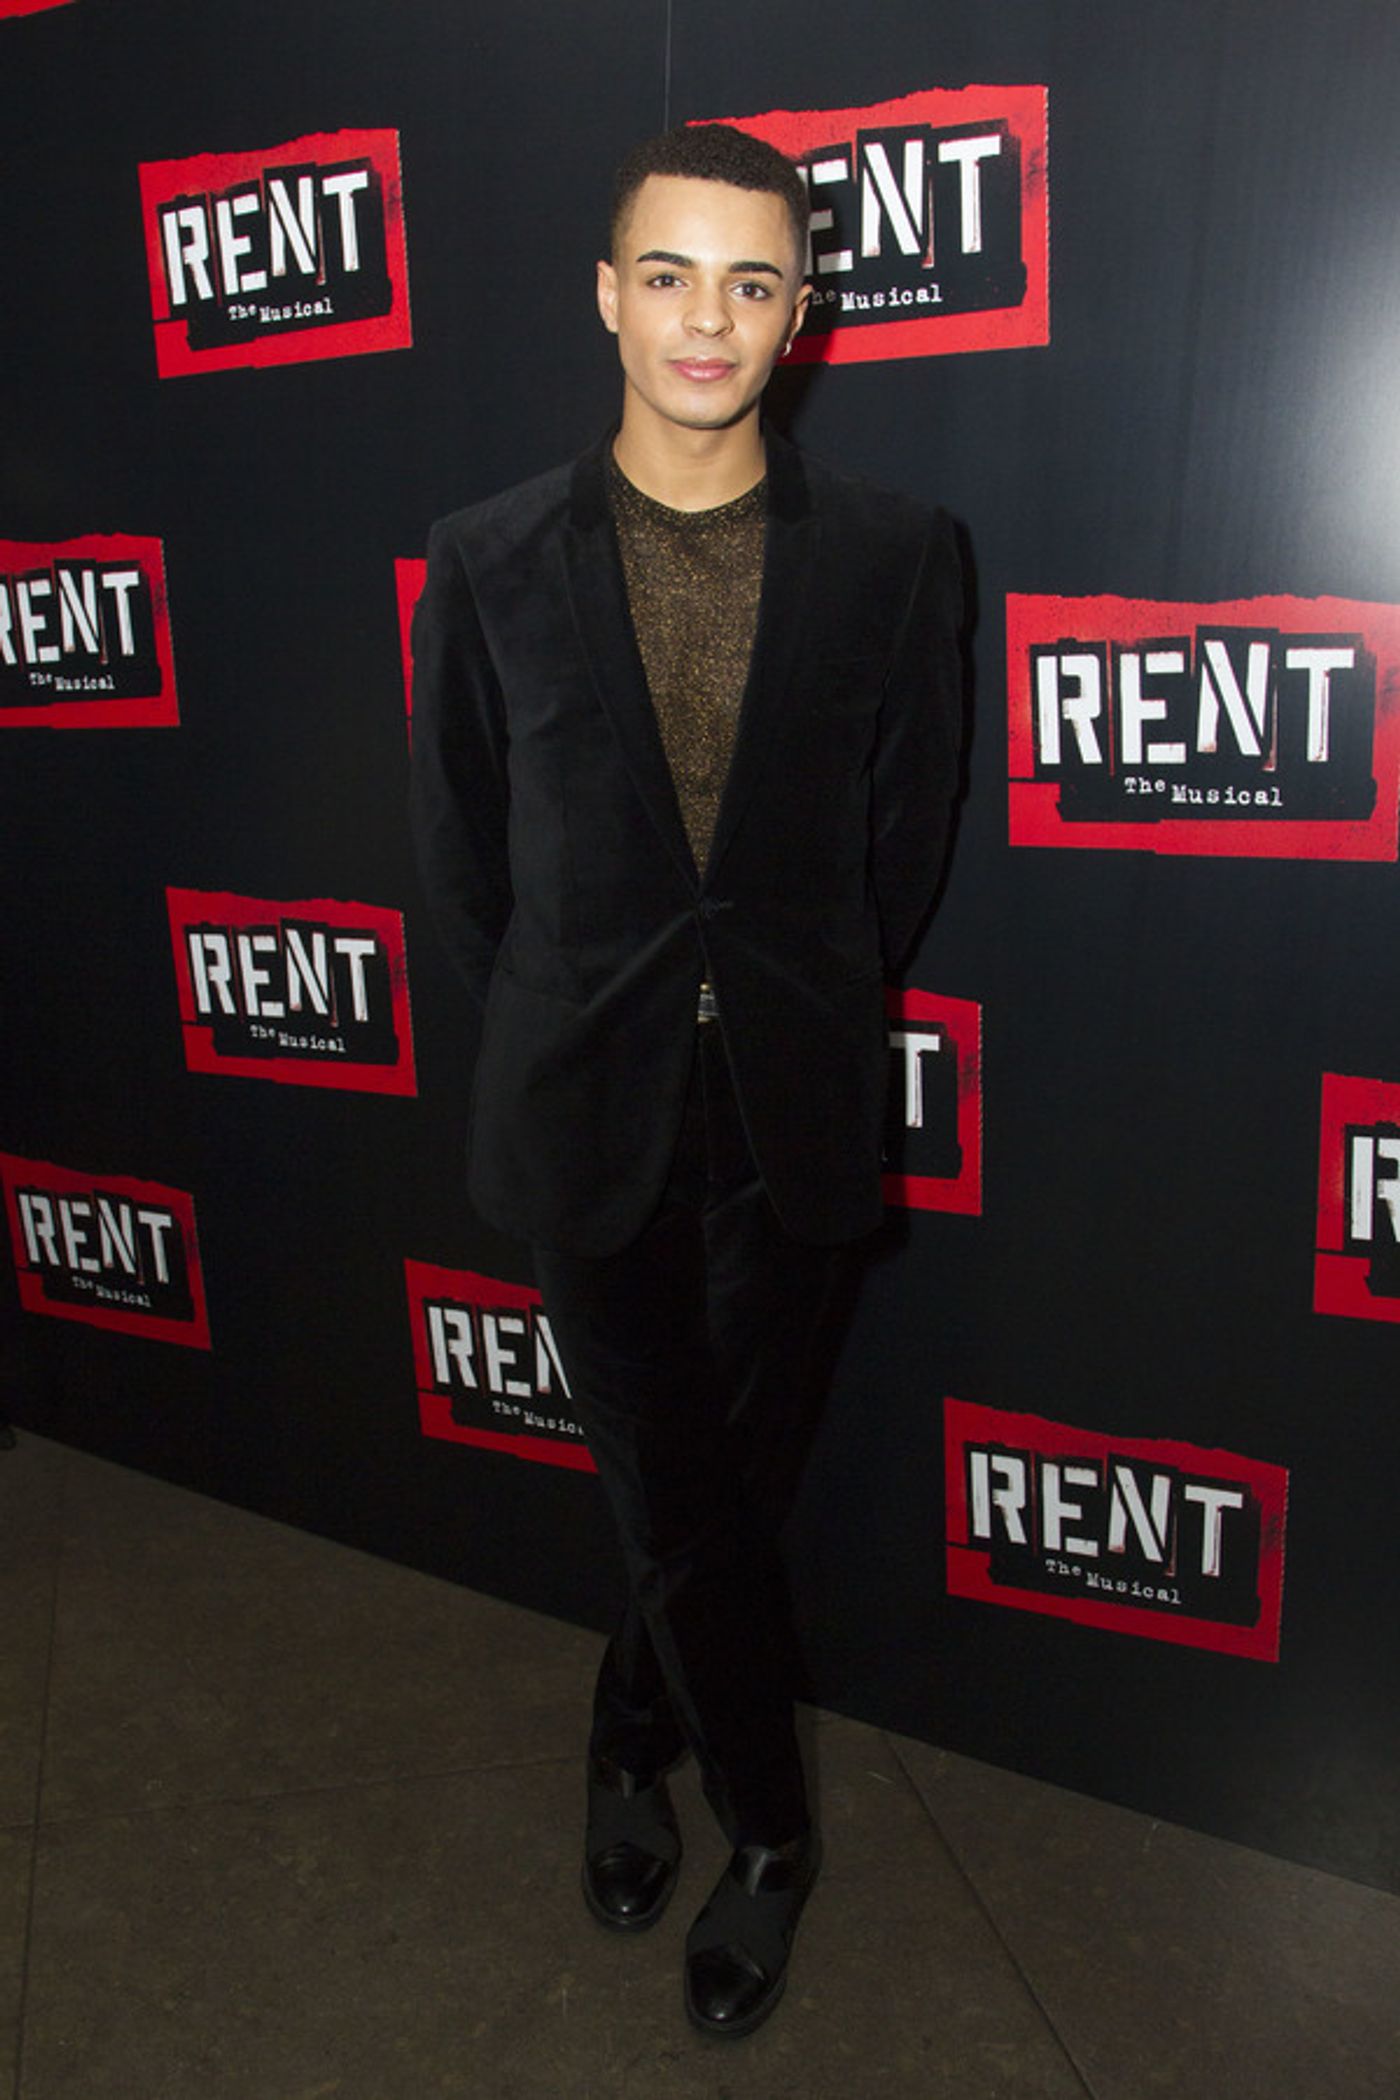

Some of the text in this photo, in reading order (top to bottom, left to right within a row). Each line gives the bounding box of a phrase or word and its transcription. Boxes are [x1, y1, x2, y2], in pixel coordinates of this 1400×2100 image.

[795, 133, 1003, 275] ENT
[162, 170, 369, 306] RENT
[228, 297, 334, 323] The Musical
[811, 283, 943, 312] he Musical
[29, 671, 115, 692] The Musical
[1036, 640, 1356, 765] RENT
[1124, 776, 1284, 807] The Musical
[188, 928, 376, 1022] RENT
[250, 1024, 346, 1053] The Musical
[18, 1194, 172, 1283] RENT
[72, 1276, 152, 1309] The Musical
[428, 1306, 572, 1399] REN
[491, 1400, 586, 1436] The Music
[969, 1451, 1243, 1578] RENT
[1044, 1559, 1182, 1604] The Musical
